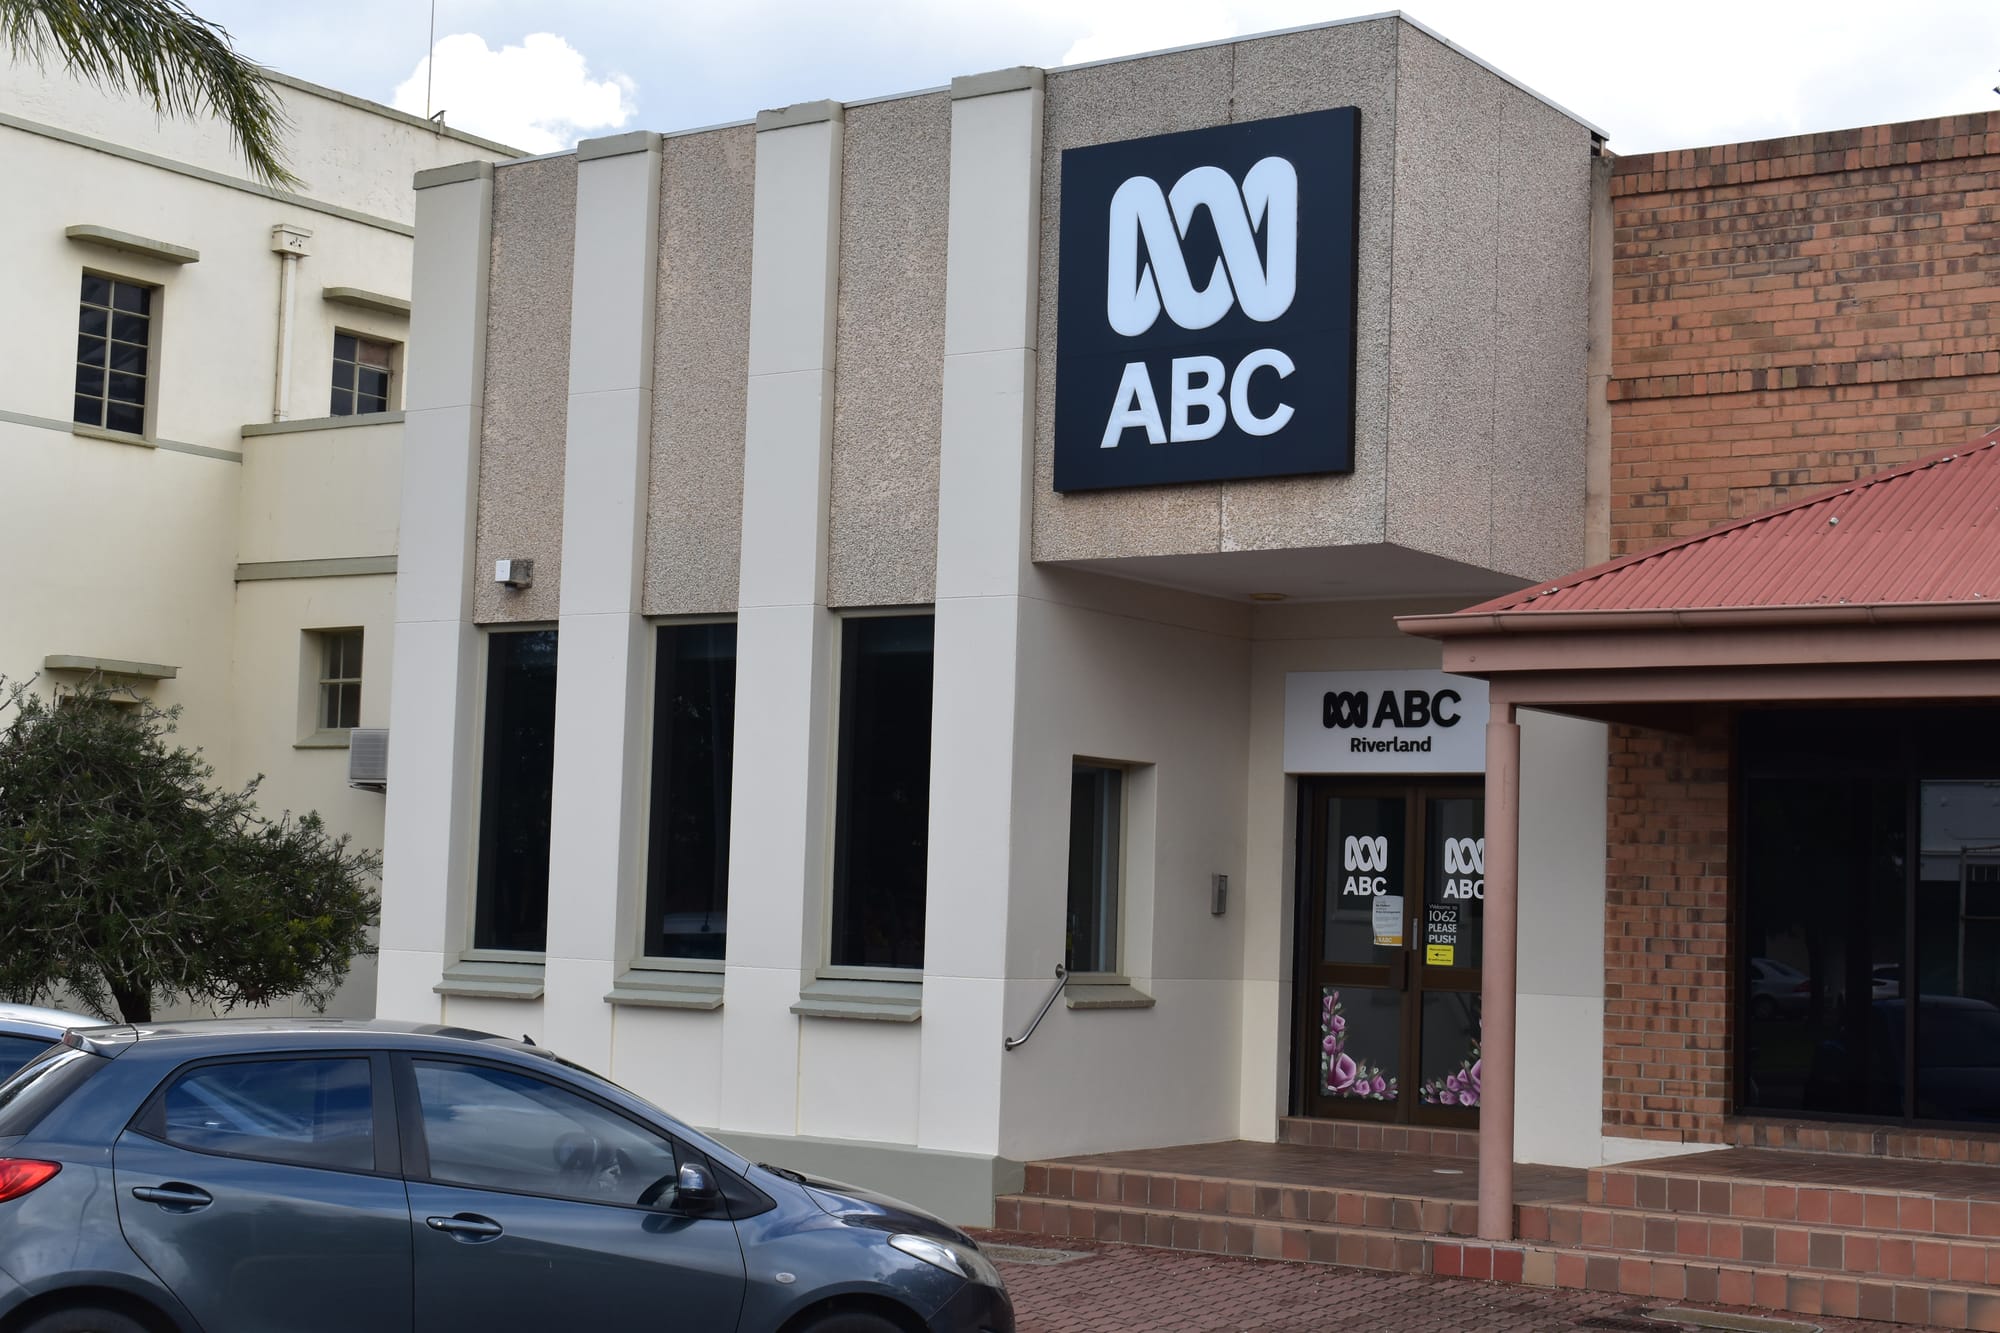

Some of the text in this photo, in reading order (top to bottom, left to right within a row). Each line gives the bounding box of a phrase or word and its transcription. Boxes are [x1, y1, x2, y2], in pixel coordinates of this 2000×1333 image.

[1100, 348, 1296, 449] ABC
[1372, 689, 1462, 728] ABC
[1350, 735, 1432, 753] Riverland
[1343, 876, 1387, 896] ABC
[1429, 910, 1457, 922] 1062
[1428, 923, 1457, 933] PLEASE
[1428, 934, 1457, 944] PUSH
